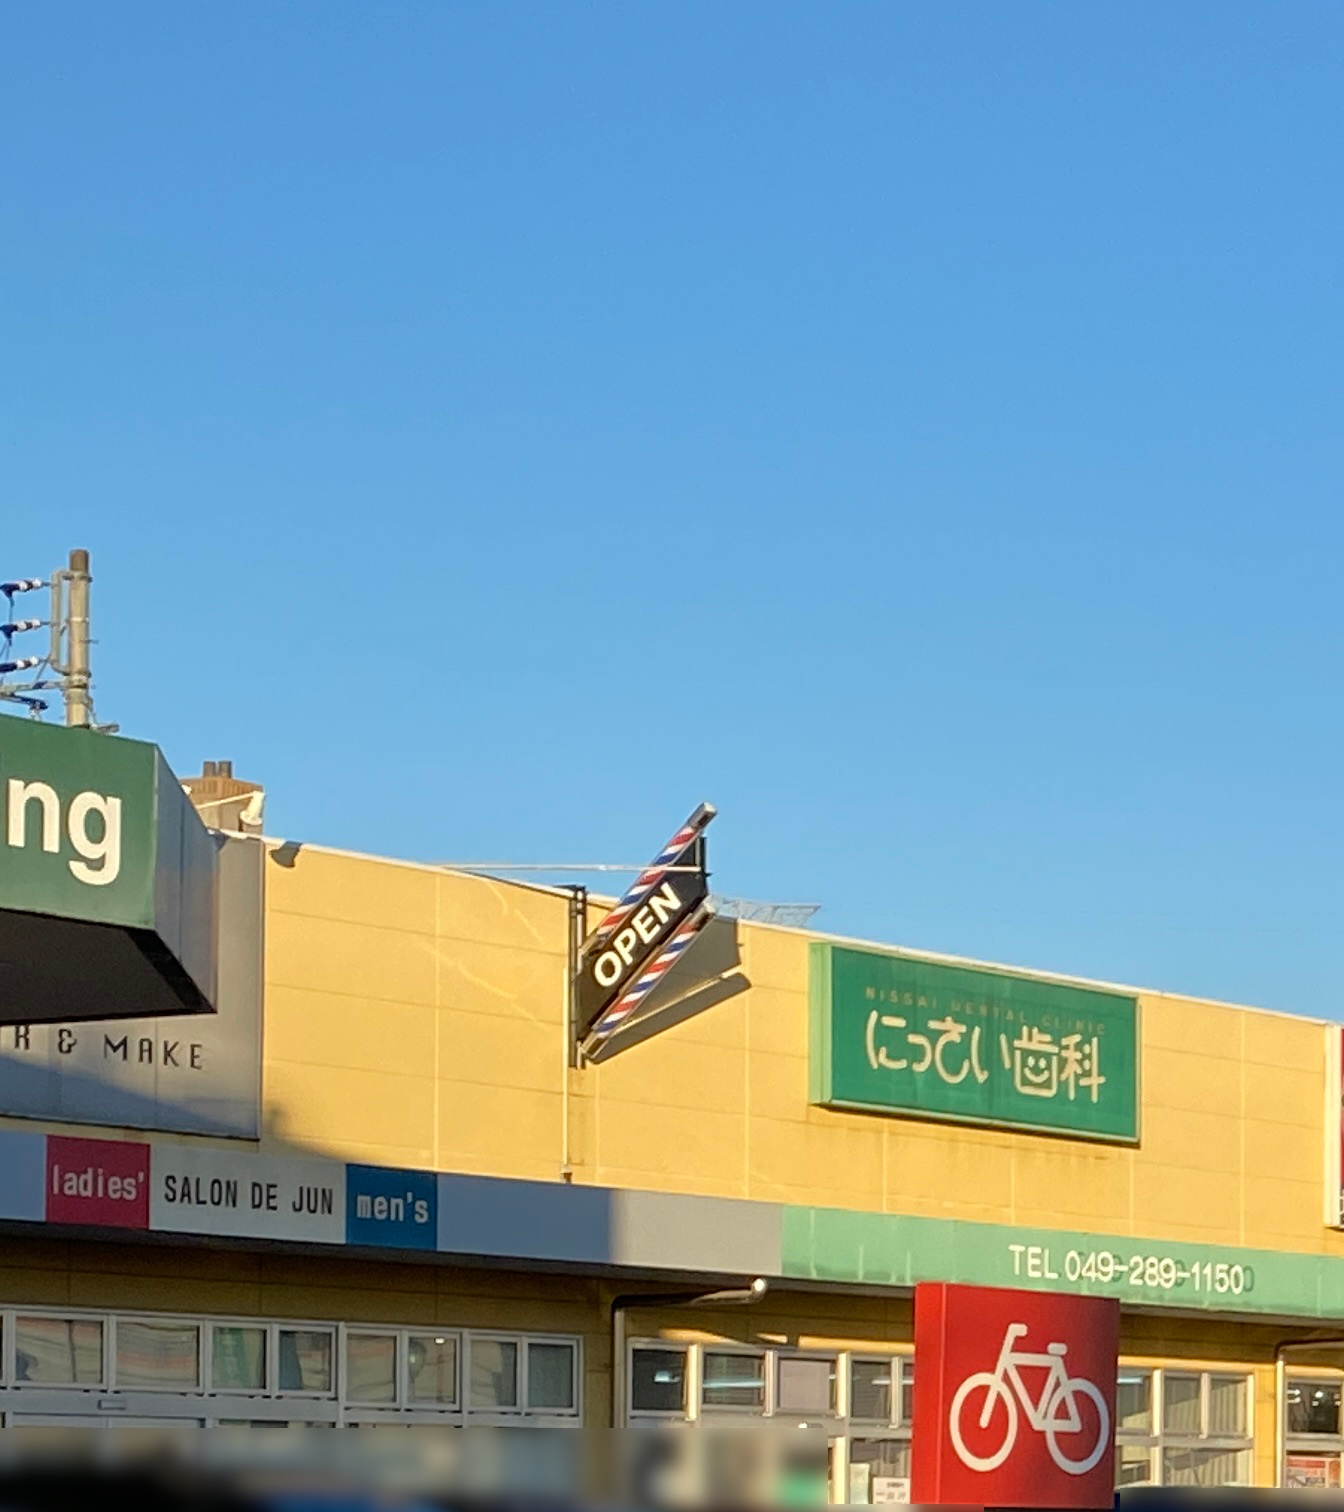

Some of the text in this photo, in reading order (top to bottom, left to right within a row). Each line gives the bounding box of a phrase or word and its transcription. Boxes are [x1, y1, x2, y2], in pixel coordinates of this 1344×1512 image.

[593, 883, 683, 990] OPEN
[865, 986, 1106, 1036] NISSAI DENTAL CLINIC
[58, 1029, 77, 1054] &
[104, 1035, 203, 1070] MAKE
[865, 1010, 1106, 1104] にっさい歯科
[53, 1165, 144, 1201] ladies'
[164, 1175, 334, 1216] SALON DE JUN
[356, 1192, 428, 1223] men's
[1008, 1244, 1244, 1295] TEL 049-289-1150
